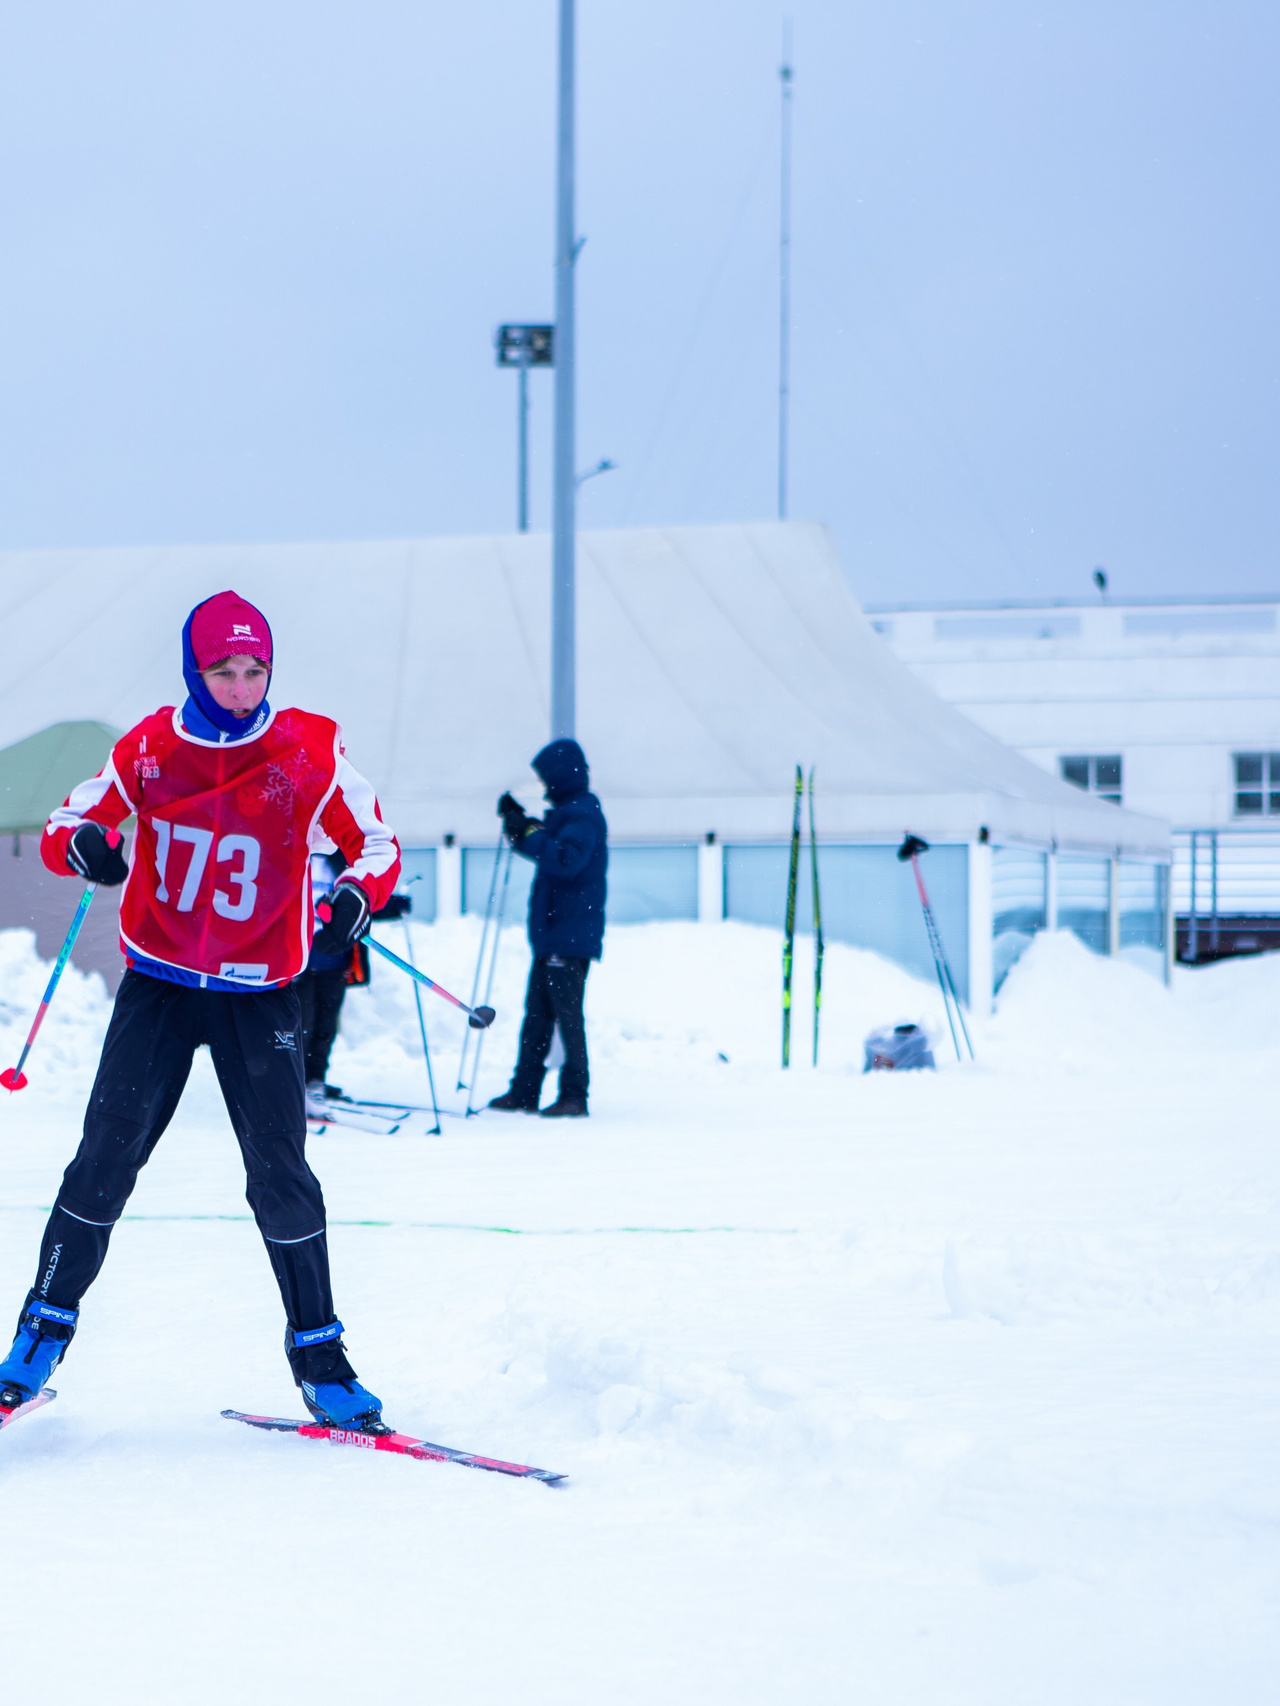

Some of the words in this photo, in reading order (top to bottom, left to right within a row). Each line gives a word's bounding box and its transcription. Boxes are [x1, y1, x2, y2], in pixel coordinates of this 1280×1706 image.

[151, 816, 261, 922] 173
[40, 1243, 63, 1297] VICTORY
[39, 1306, 75, 1322] SPINE
[302, 1327, 336, 1342] SPINE
[330, 1429, 376, 1449] BRADOS
